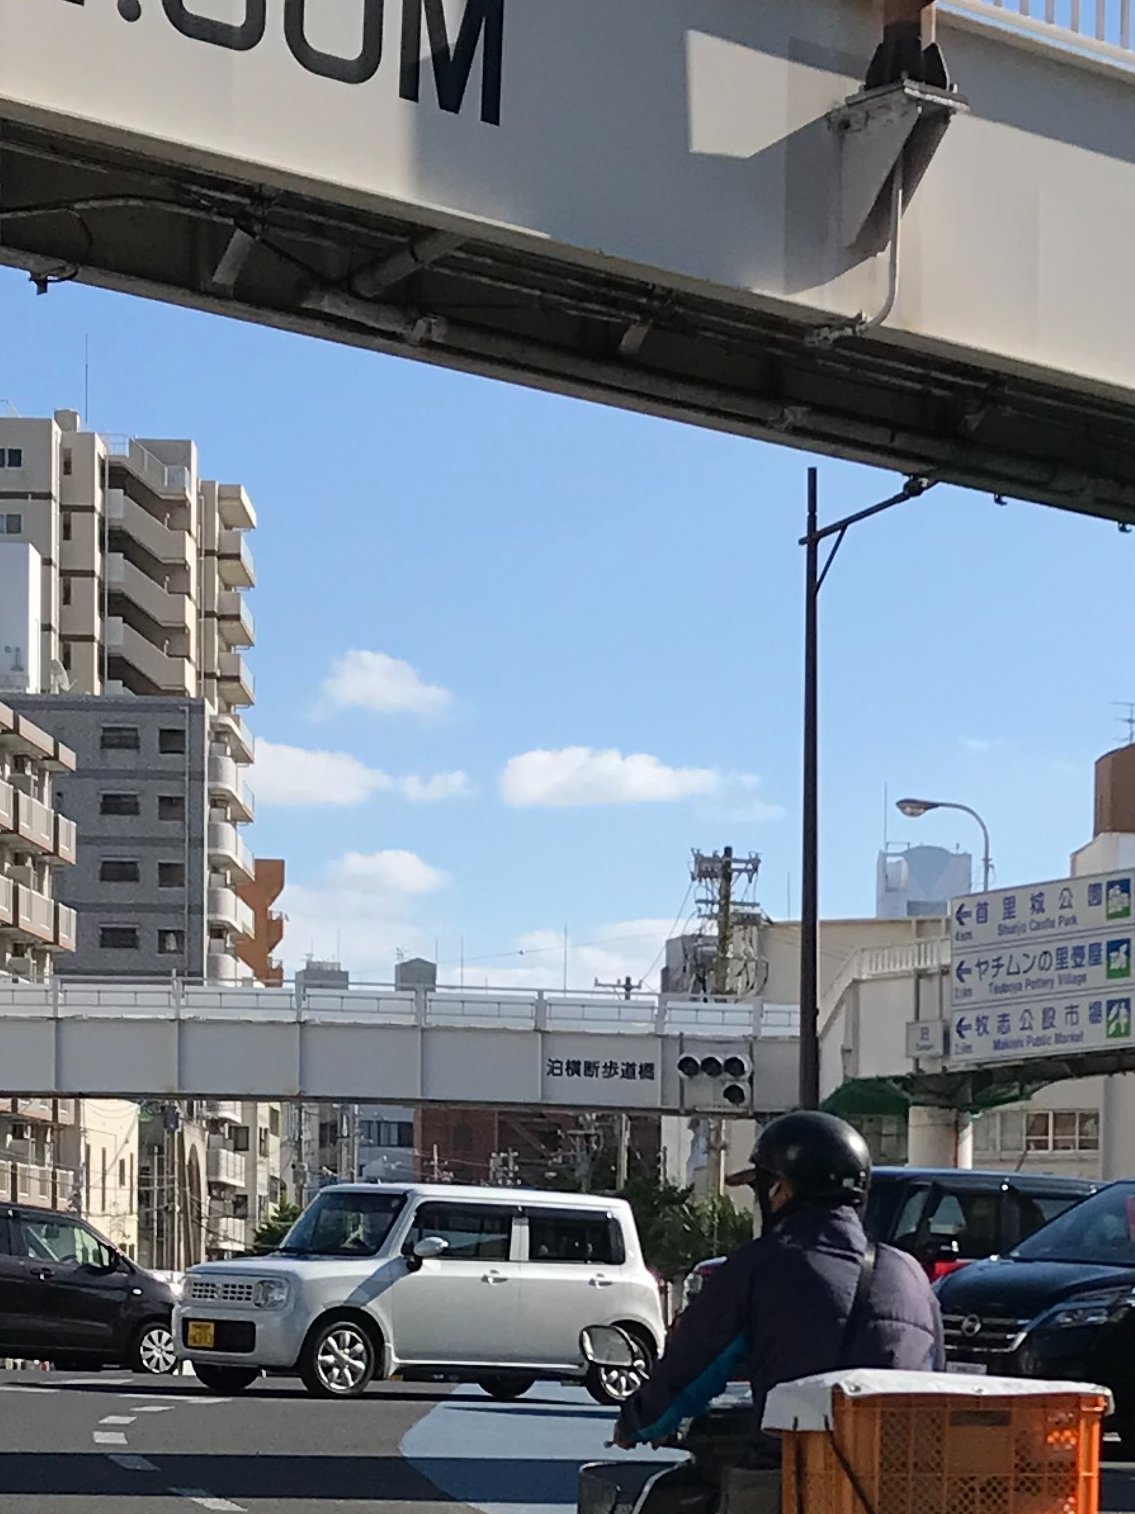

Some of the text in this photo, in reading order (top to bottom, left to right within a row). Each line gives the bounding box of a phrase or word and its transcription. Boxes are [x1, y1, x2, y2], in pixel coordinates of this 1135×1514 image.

[975, 882, 1103, 924] 首里城公園
[1058, 914, 1078, 927] Park
[974, 1001, 1103, 1038] 牧志公設市場
[546, 1058, 655, 1081] 泊横断歩道橋
